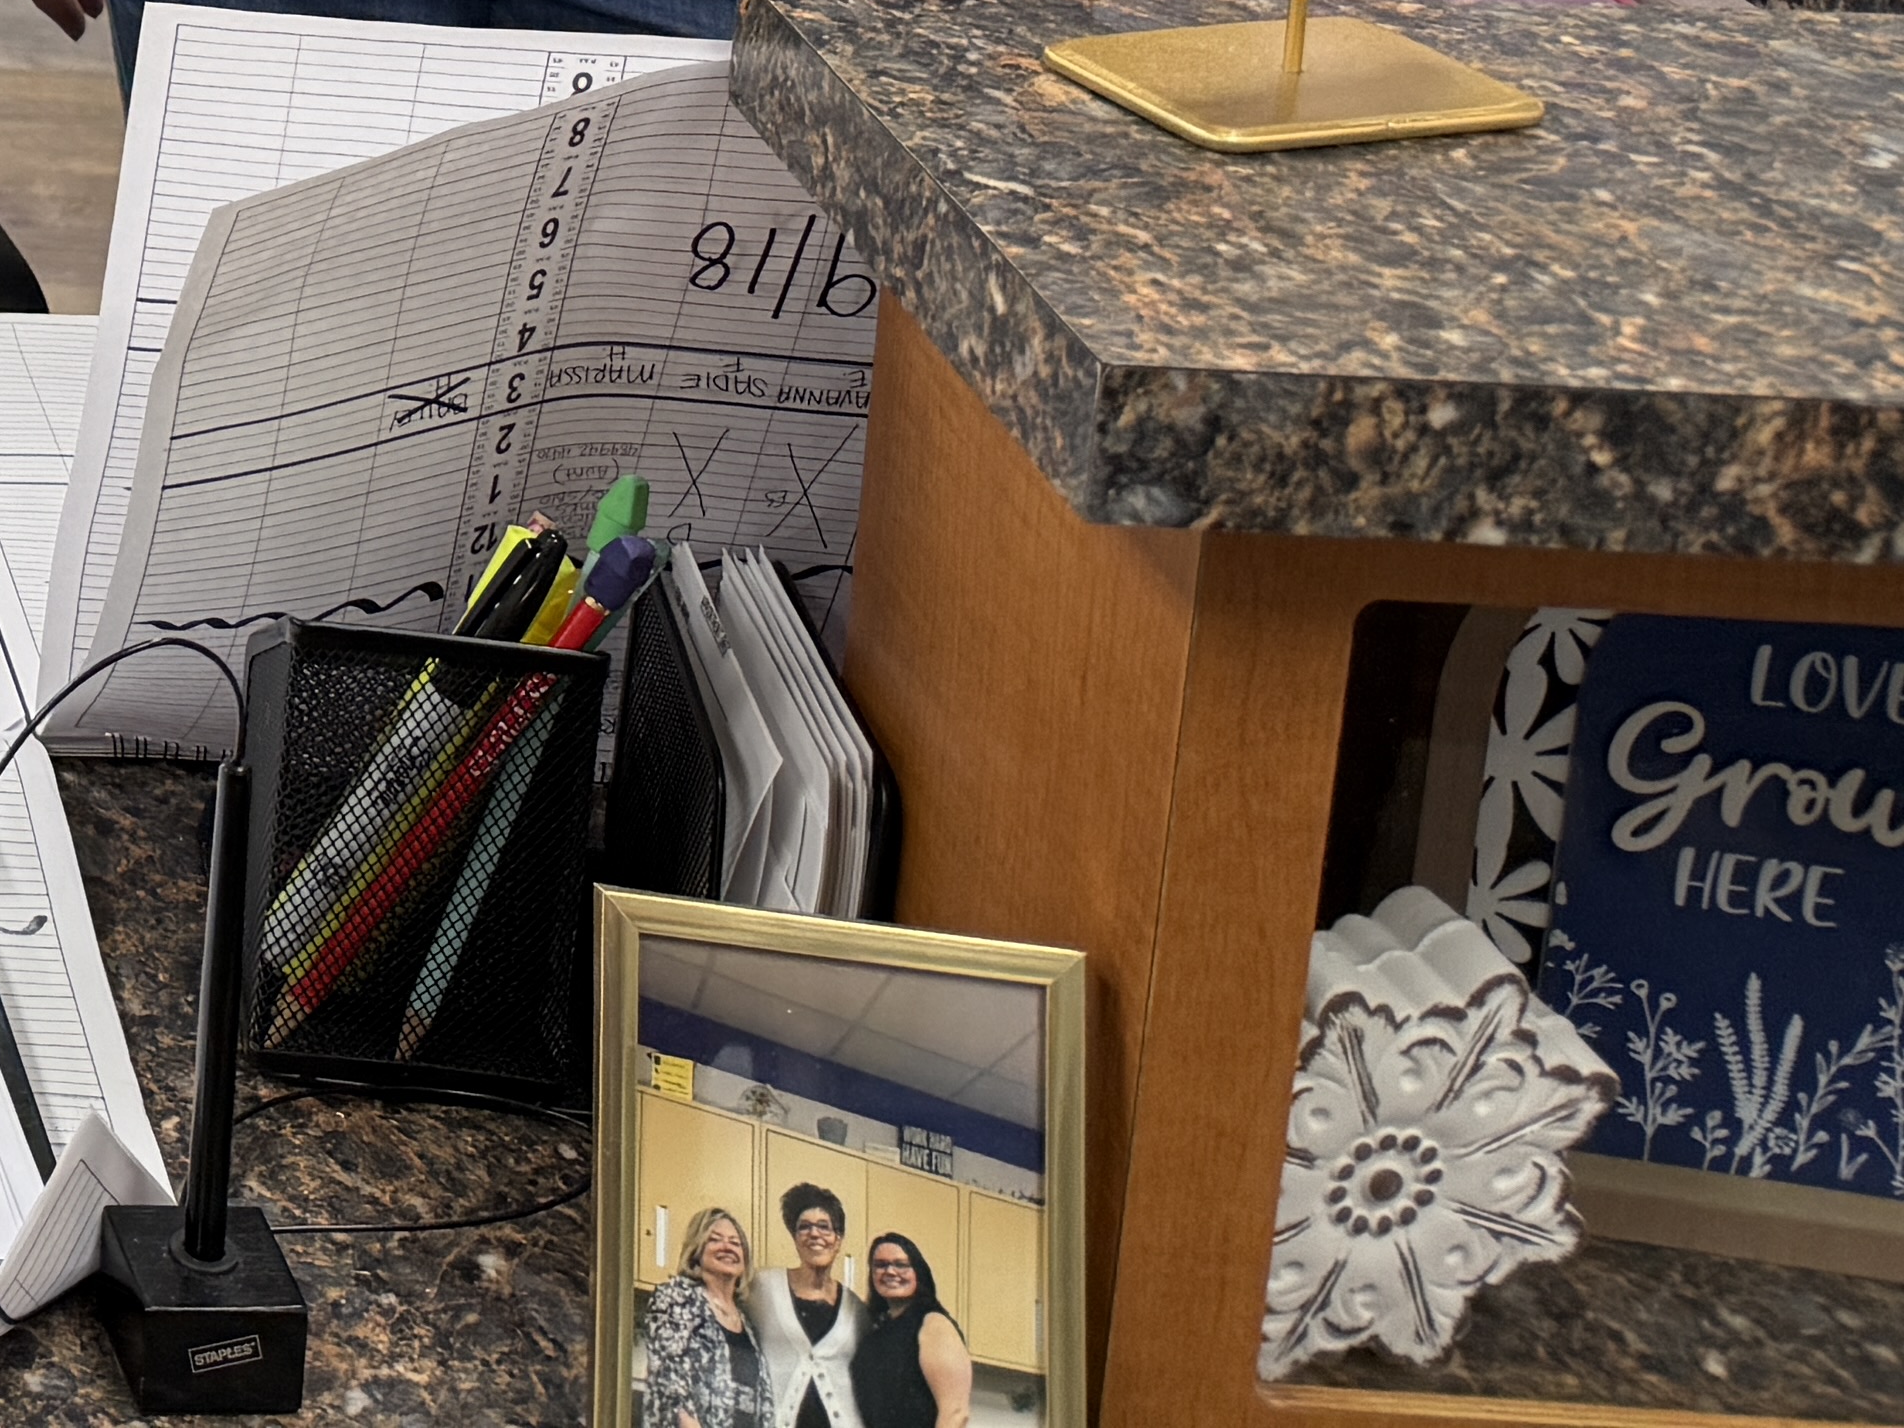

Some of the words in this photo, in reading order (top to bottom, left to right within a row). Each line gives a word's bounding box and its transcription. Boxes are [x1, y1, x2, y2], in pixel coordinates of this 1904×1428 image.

[569, 117, 591, 148] 8
[551, 166, 573, 198] 7
[542, 218, 559, 249] 6
[689, 215, 878, 320] 9/18
[529, 269, 548, 301] 5
[516, 321, 537, 352] 4
[506, 373, 526, 403] 3
[547, 364, 657, 388] MARISSA
[680, 373, 769, 394] SADIE
[778, 384, 871, 411] AVANNA
[496, 422, 515, 454] 2
[488, 473, 503, 504] 1
[1672, 846, 1845, 928] HERE
[193, 1344, 254, 1367] STAPLES
